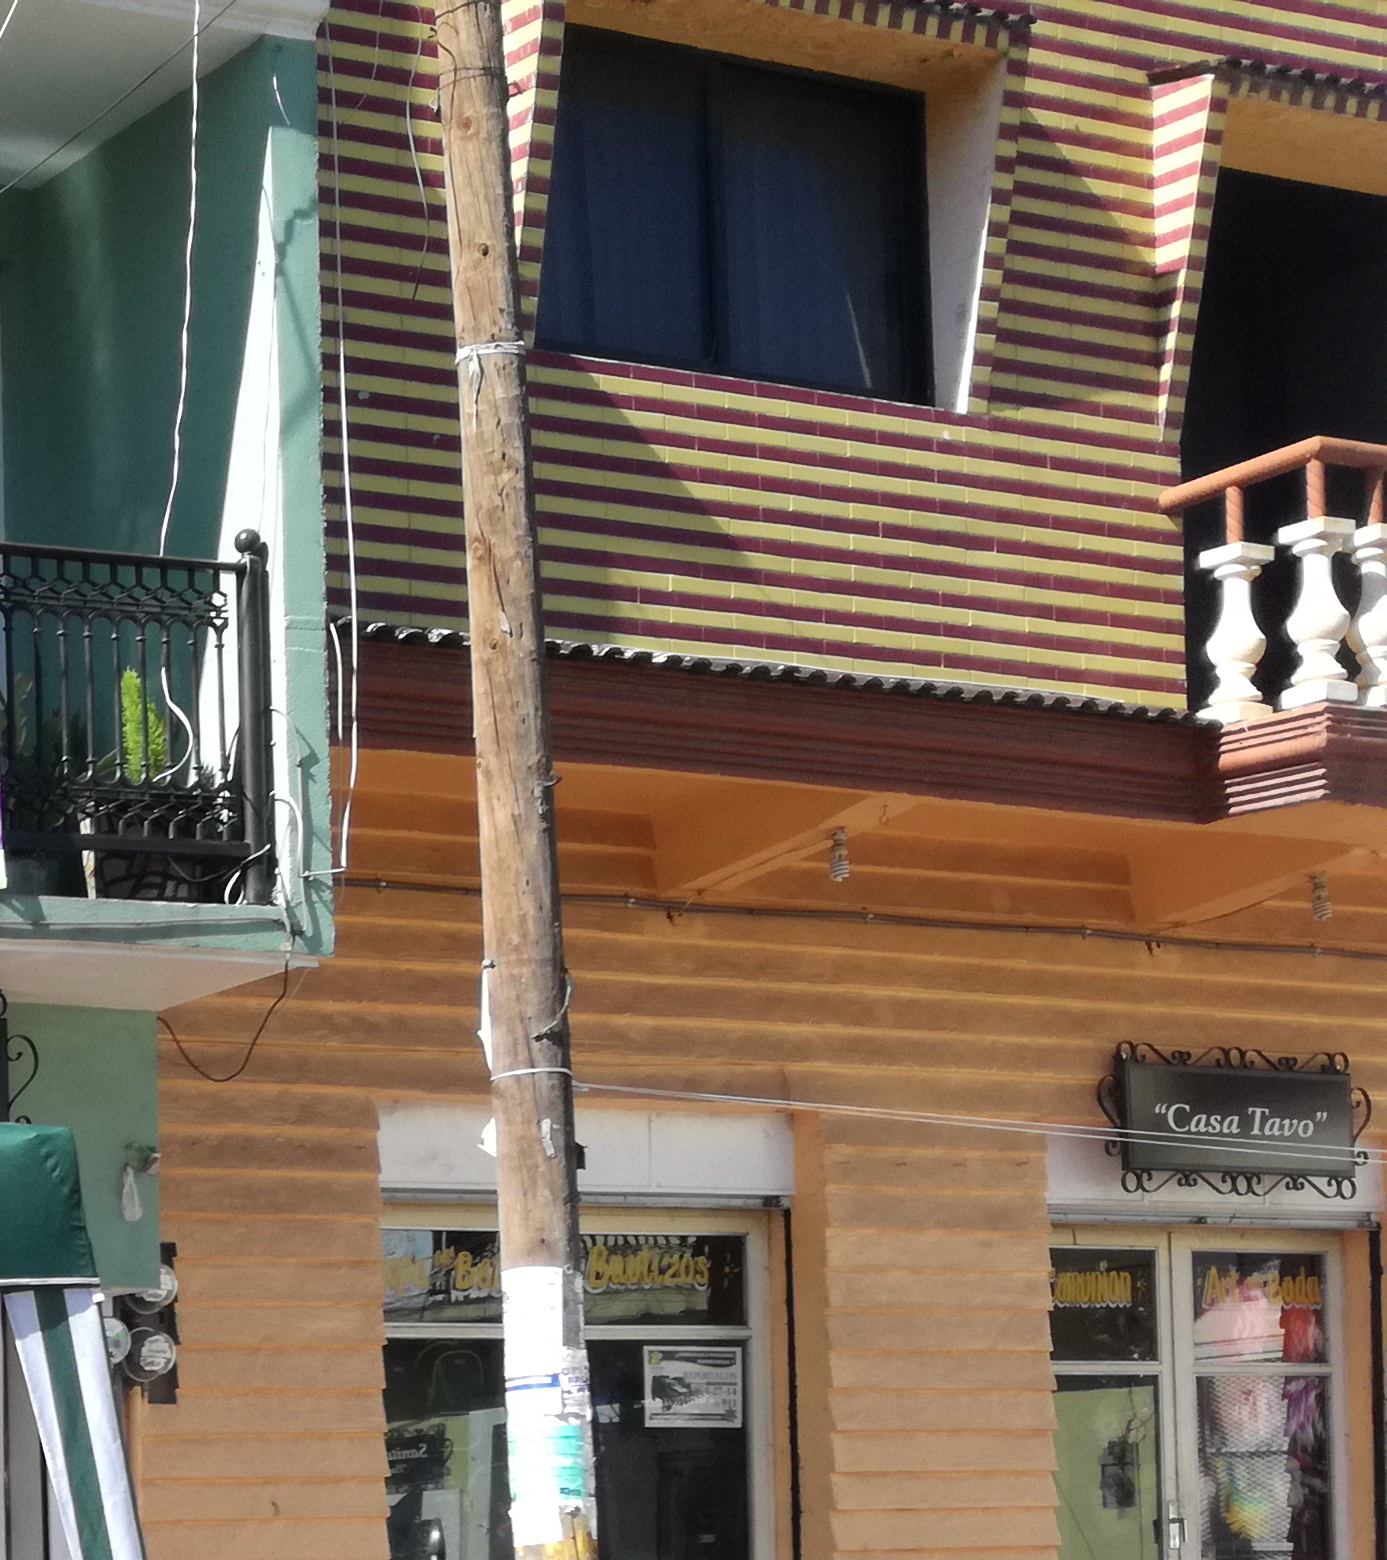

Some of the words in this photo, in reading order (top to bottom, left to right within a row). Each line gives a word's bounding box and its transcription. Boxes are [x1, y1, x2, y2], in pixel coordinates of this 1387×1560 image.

[1155, 1103, 1241, 1135] “Casa
[1248, 1107, 1328, 1138] Tavo”
[588, 1245, 710, 1292] Bautizos
